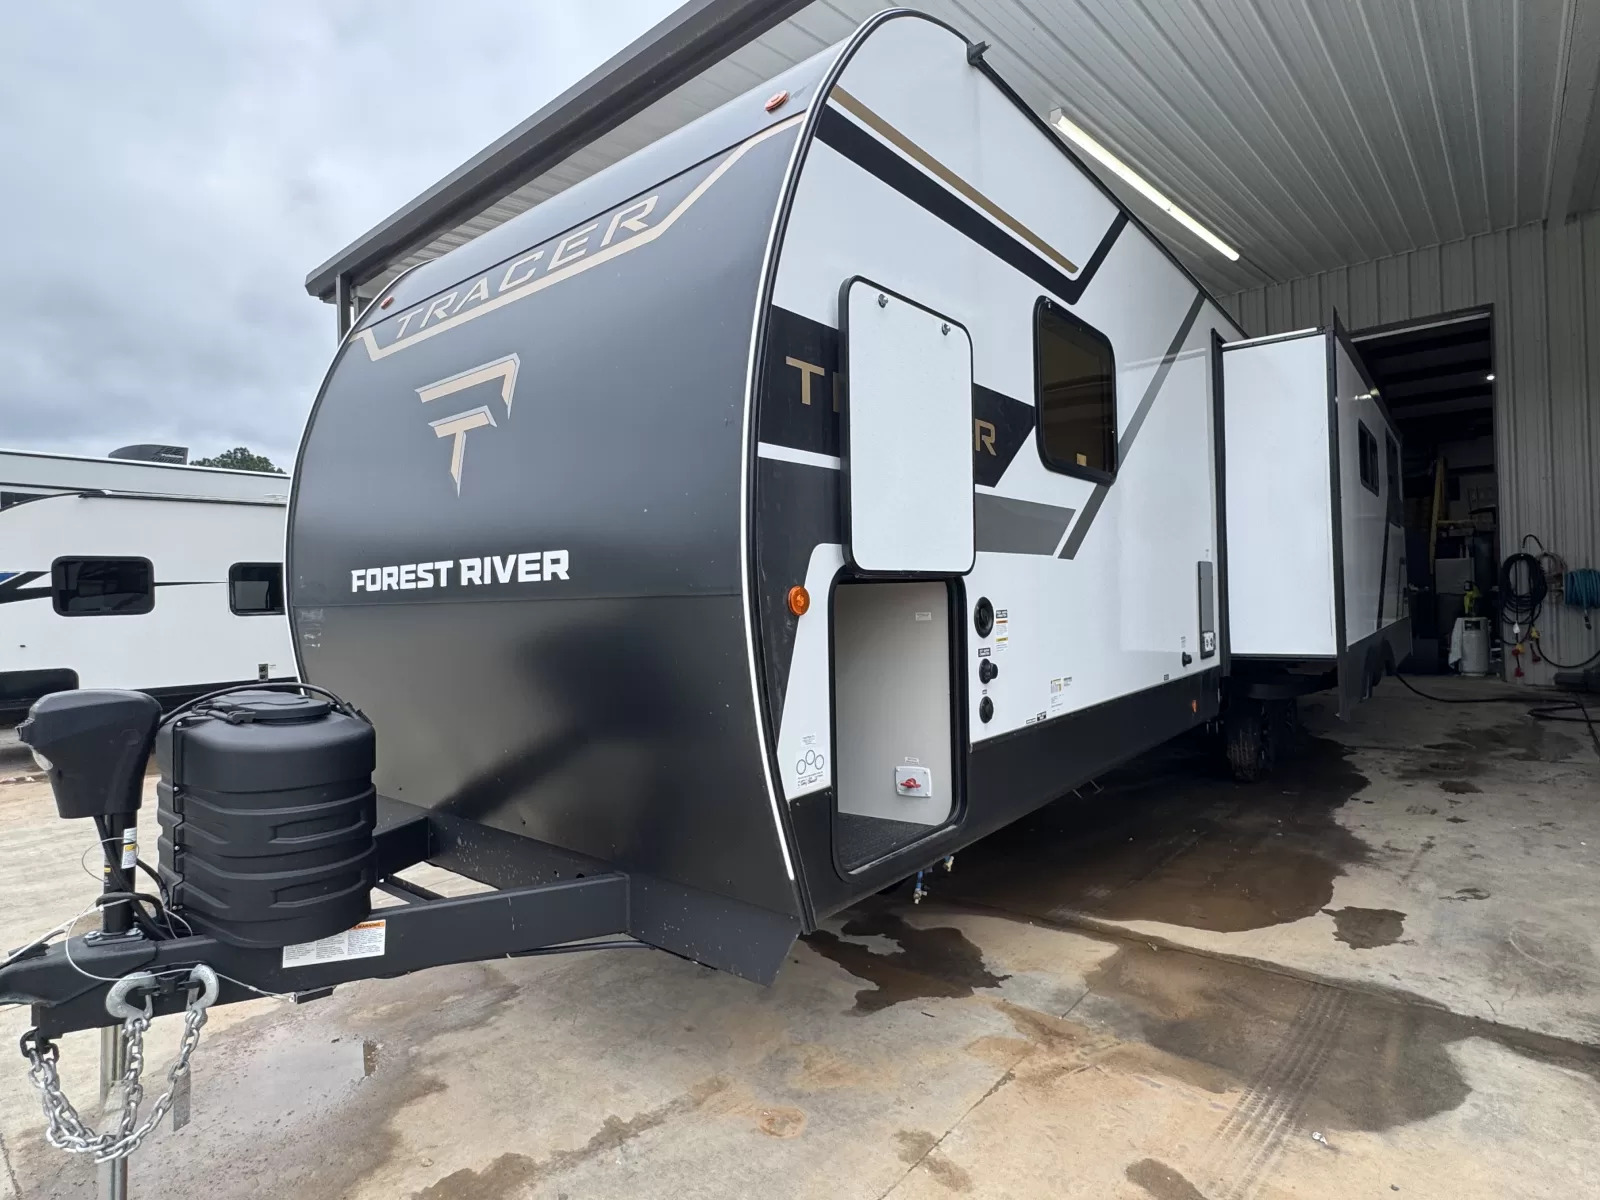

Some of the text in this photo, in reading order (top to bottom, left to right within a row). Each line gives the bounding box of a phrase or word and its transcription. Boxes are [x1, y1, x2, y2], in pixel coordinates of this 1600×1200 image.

[396, 195, 659, 340] TRACER
[351, 549, 570, 592] FOREST RIVER
